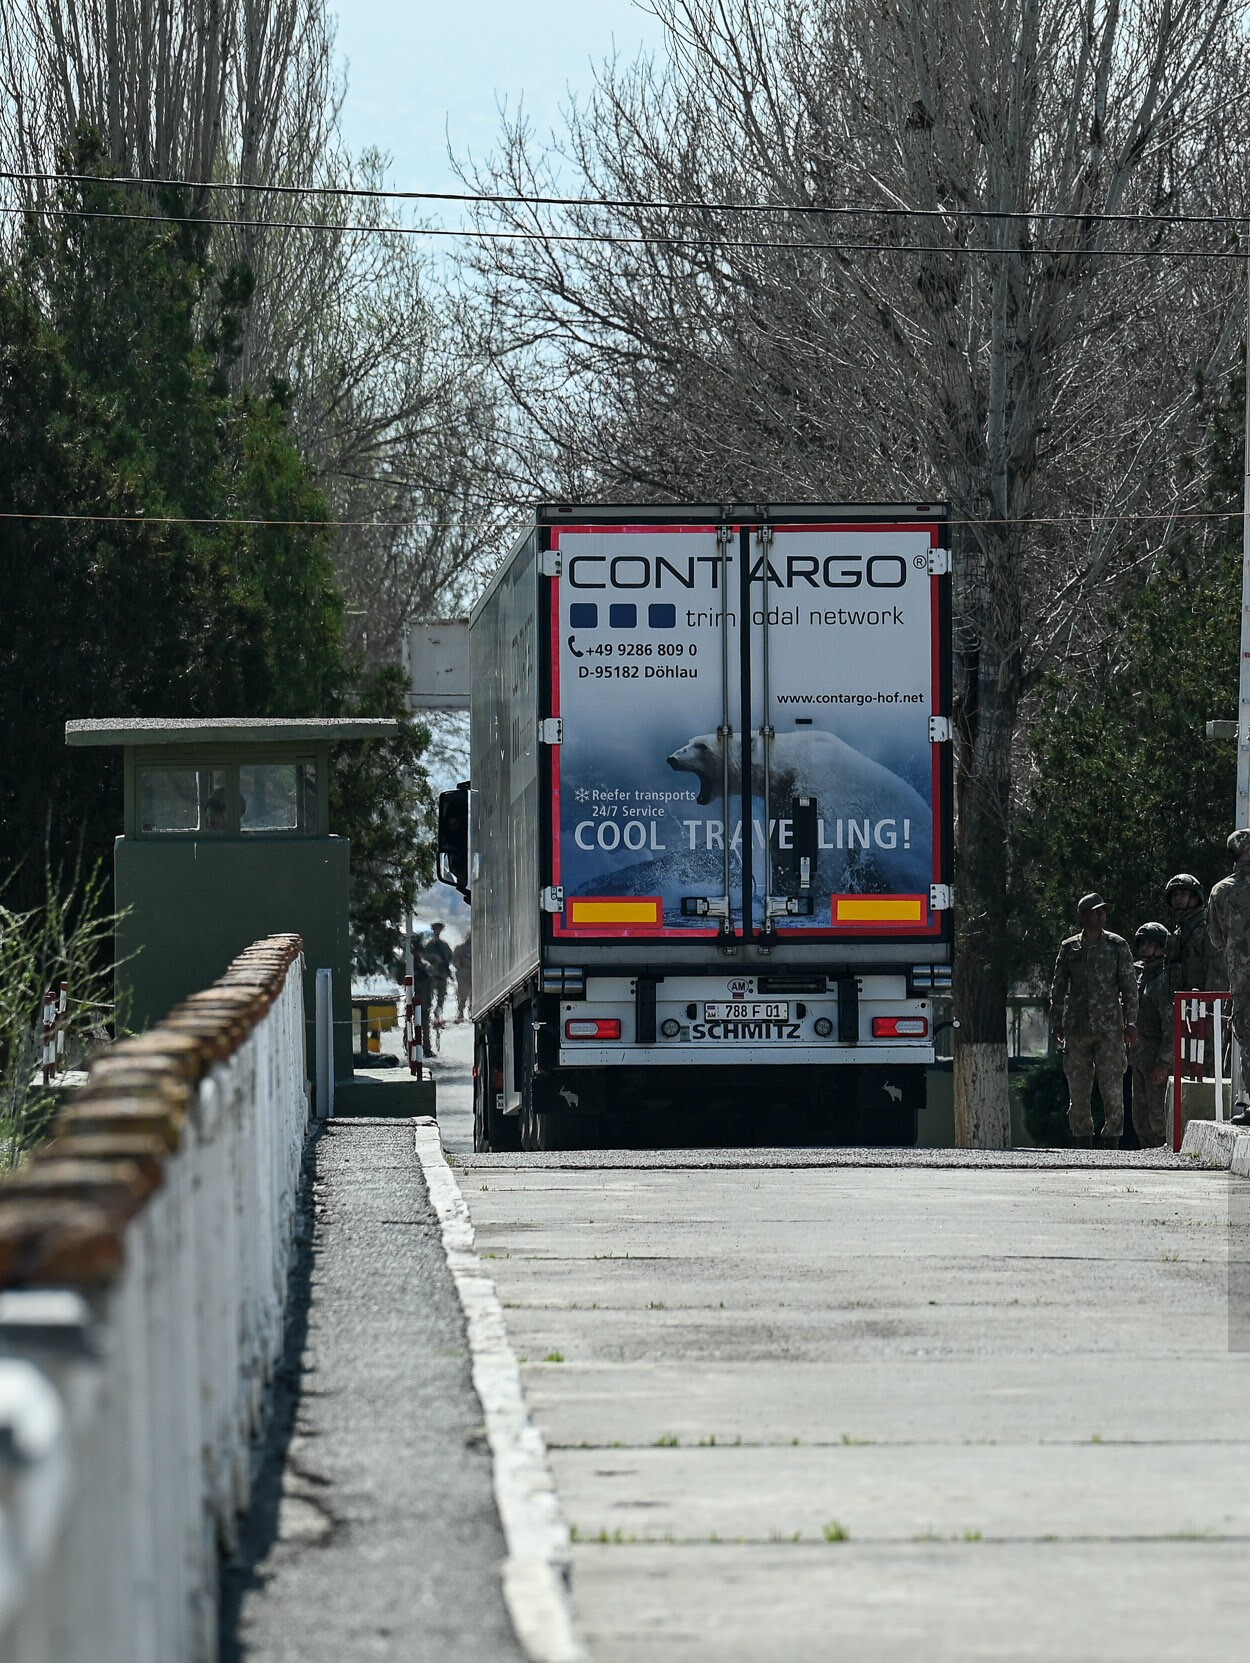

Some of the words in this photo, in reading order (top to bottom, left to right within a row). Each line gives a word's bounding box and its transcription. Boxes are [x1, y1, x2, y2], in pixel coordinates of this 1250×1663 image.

[809, 606, 905, 626] network
[586, 643, 613, 656] +49
[617, 643, 653, 656] 9286
[657, 643, 684, 656] 809
[688, 643, 698, 656] 0
[578, 666, 640, 679] D-95182
[644, 665, 698, 679] Döhlau
[776, 691, 924, 706] www.contargo-hof.net
[592, 788, 631, 801] Reefer
[634, 789, 696, 803] transports
[592, 805, 618, 817] 24/7
[622, 805, 665, 817] Service
[574, 820, 666, 850] COOL
[682, 818, 911, 850] TRAVELING!
[731, 982, 746, 991] AM
[725, 1004, 748, 1018] 788
[752, 1004, 761, 1018] F
[765, 1004, 781, 1018] 01
[692, 1023, 801, 1039] SCHMITZ
